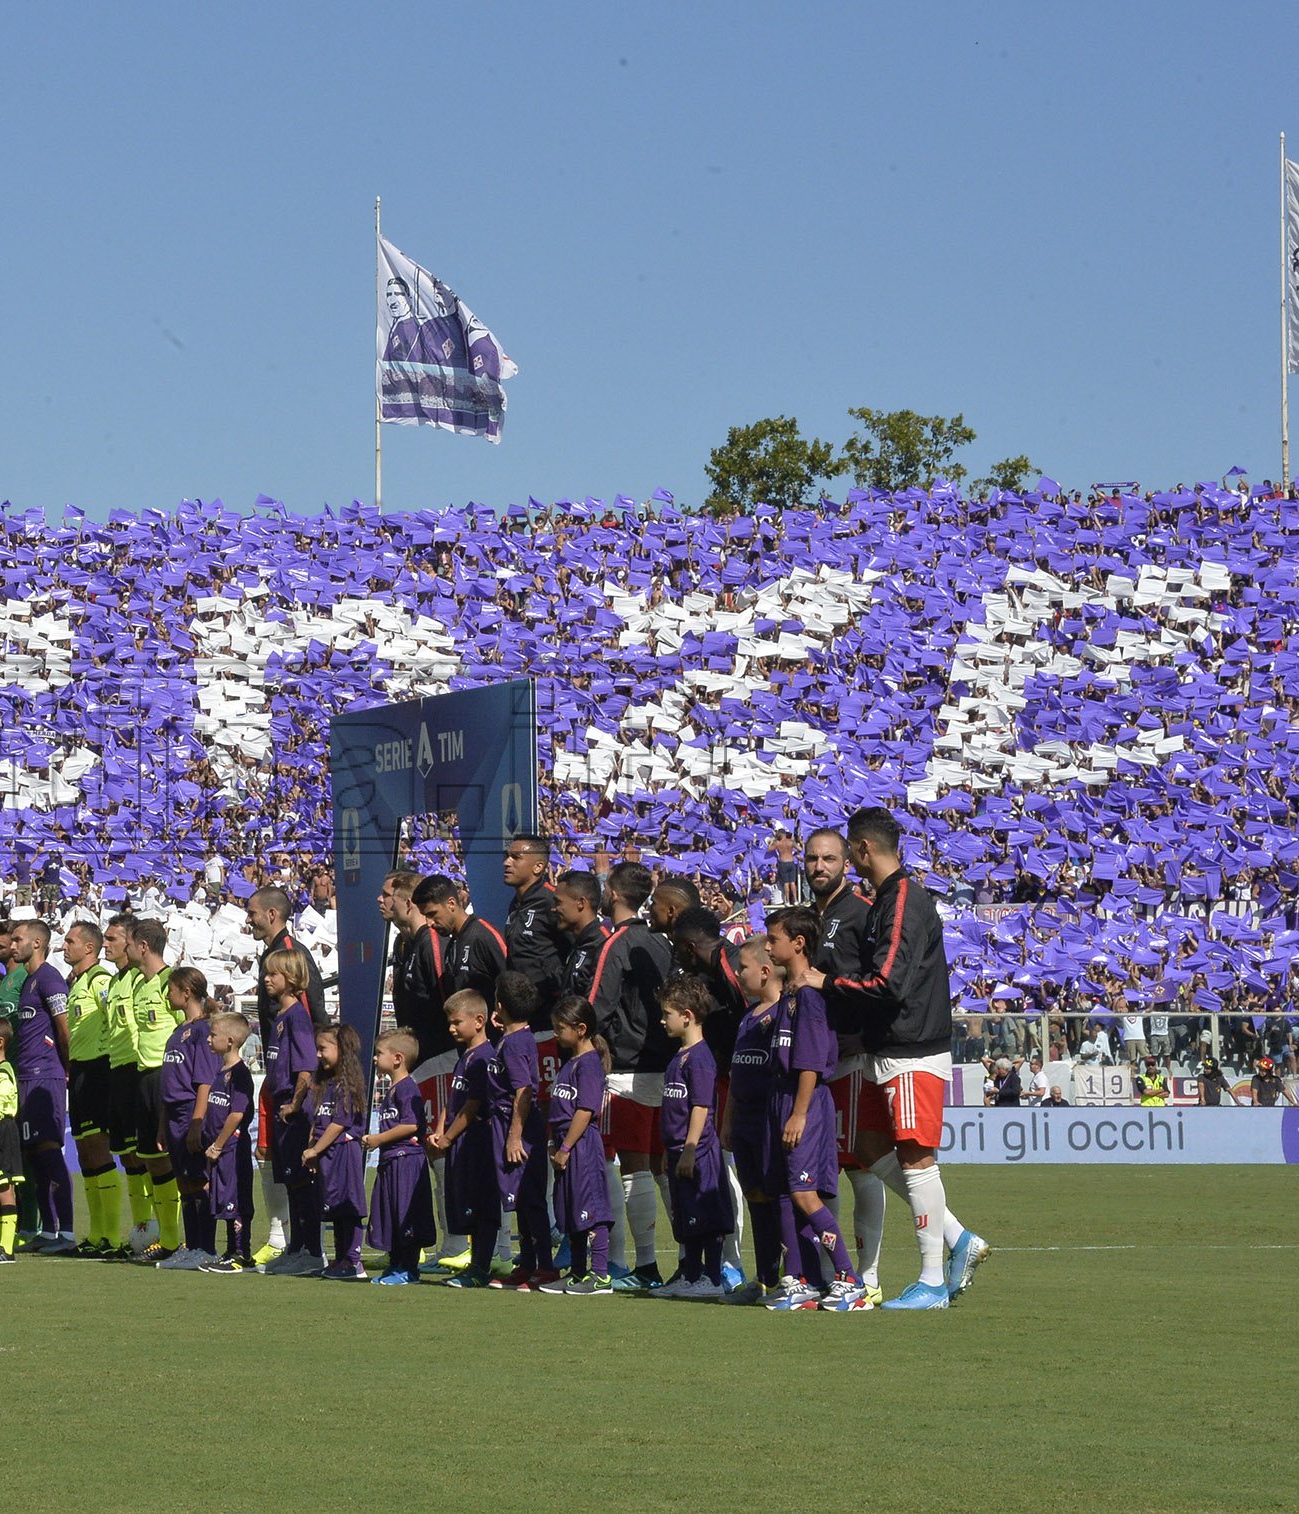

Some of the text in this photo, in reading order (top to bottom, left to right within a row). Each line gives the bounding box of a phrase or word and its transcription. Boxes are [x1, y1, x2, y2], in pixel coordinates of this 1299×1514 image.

[374, 721, 464, 778] SERIE A TIM
[1002, 1111, 1050, 1161] gli
[1067, 1110, 1185, 1151] occhi
